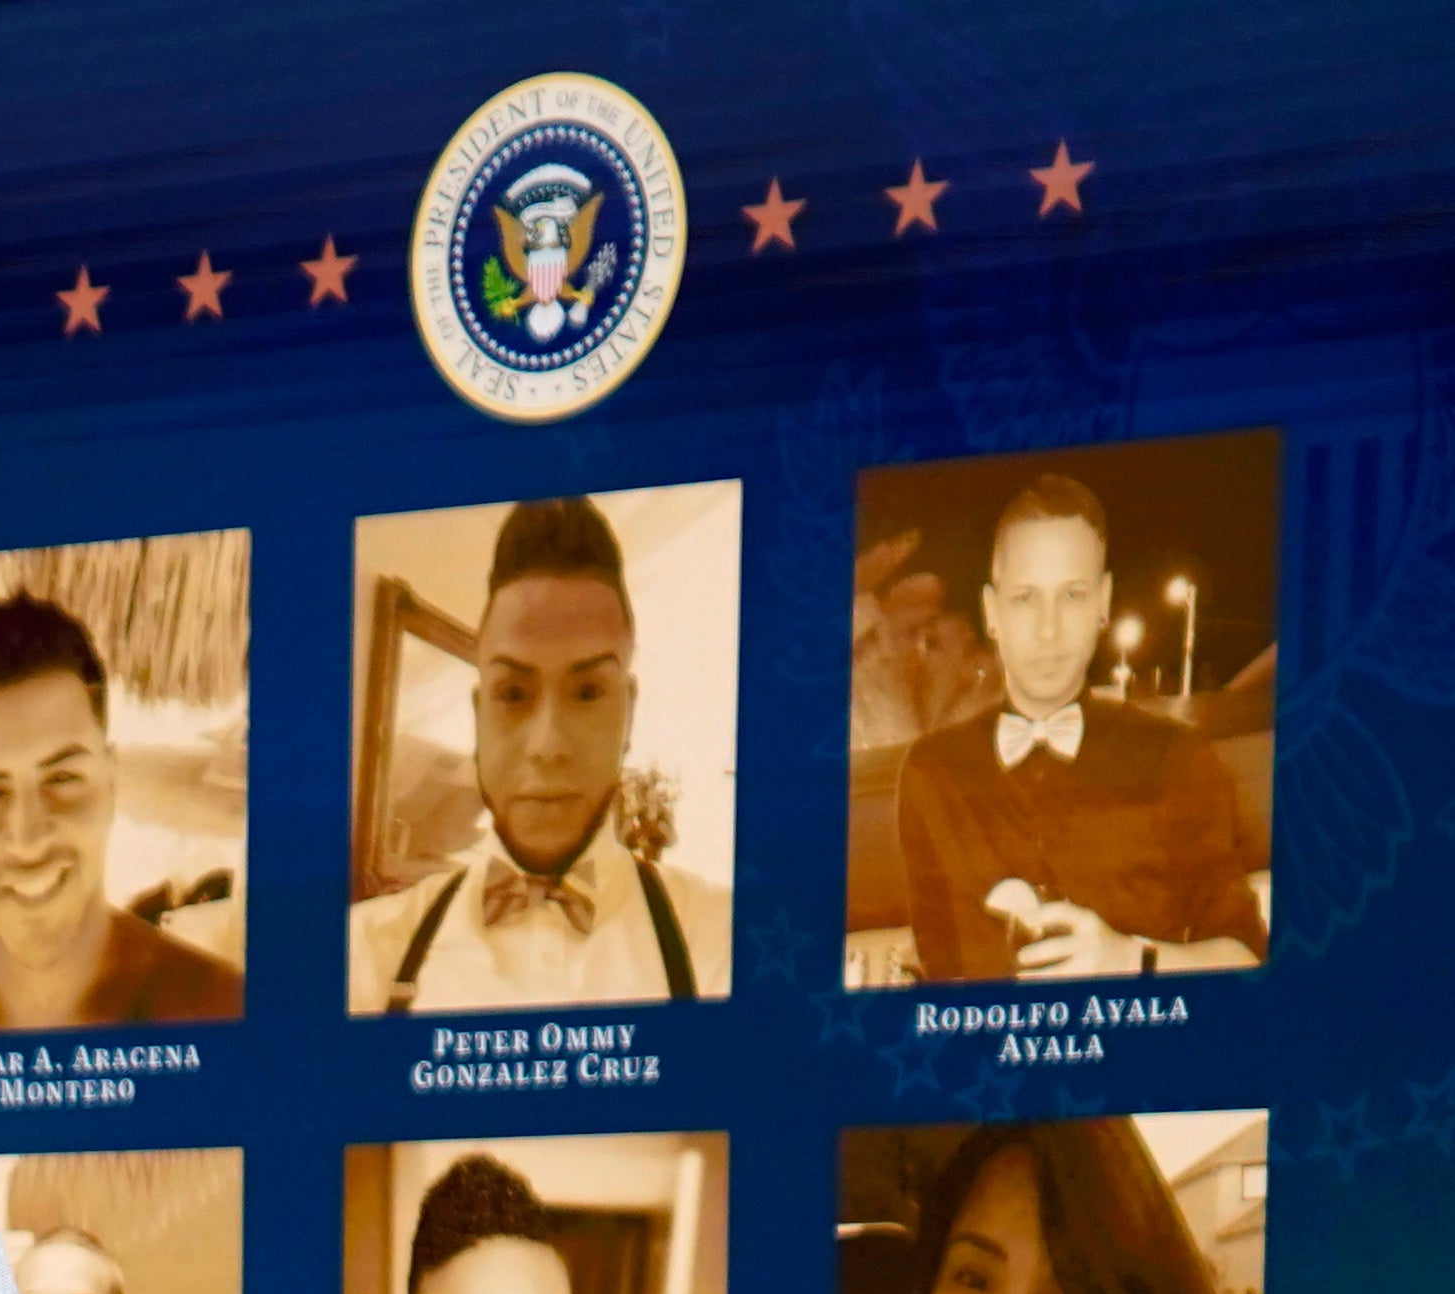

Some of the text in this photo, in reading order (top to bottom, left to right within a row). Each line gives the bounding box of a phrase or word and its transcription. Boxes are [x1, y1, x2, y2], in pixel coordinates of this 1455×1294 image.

[424, 86, 546, 251] PRESIDENT
[624, 117, 676, 259] UNITED
[573, 280, 664, 392] STATES
[916, 994, 1190, 1035] RODOLFO AYALA
[30, 1045, 64, 1077] A.
[72, 1043, 202, 1074] ARACENA
[432, 1022, 637, 1059] PETER OMMY
[998, 1032, 1105, 1065] AYALA
[410, 1052, 661, 1092] GONZALEZ CRUZ
